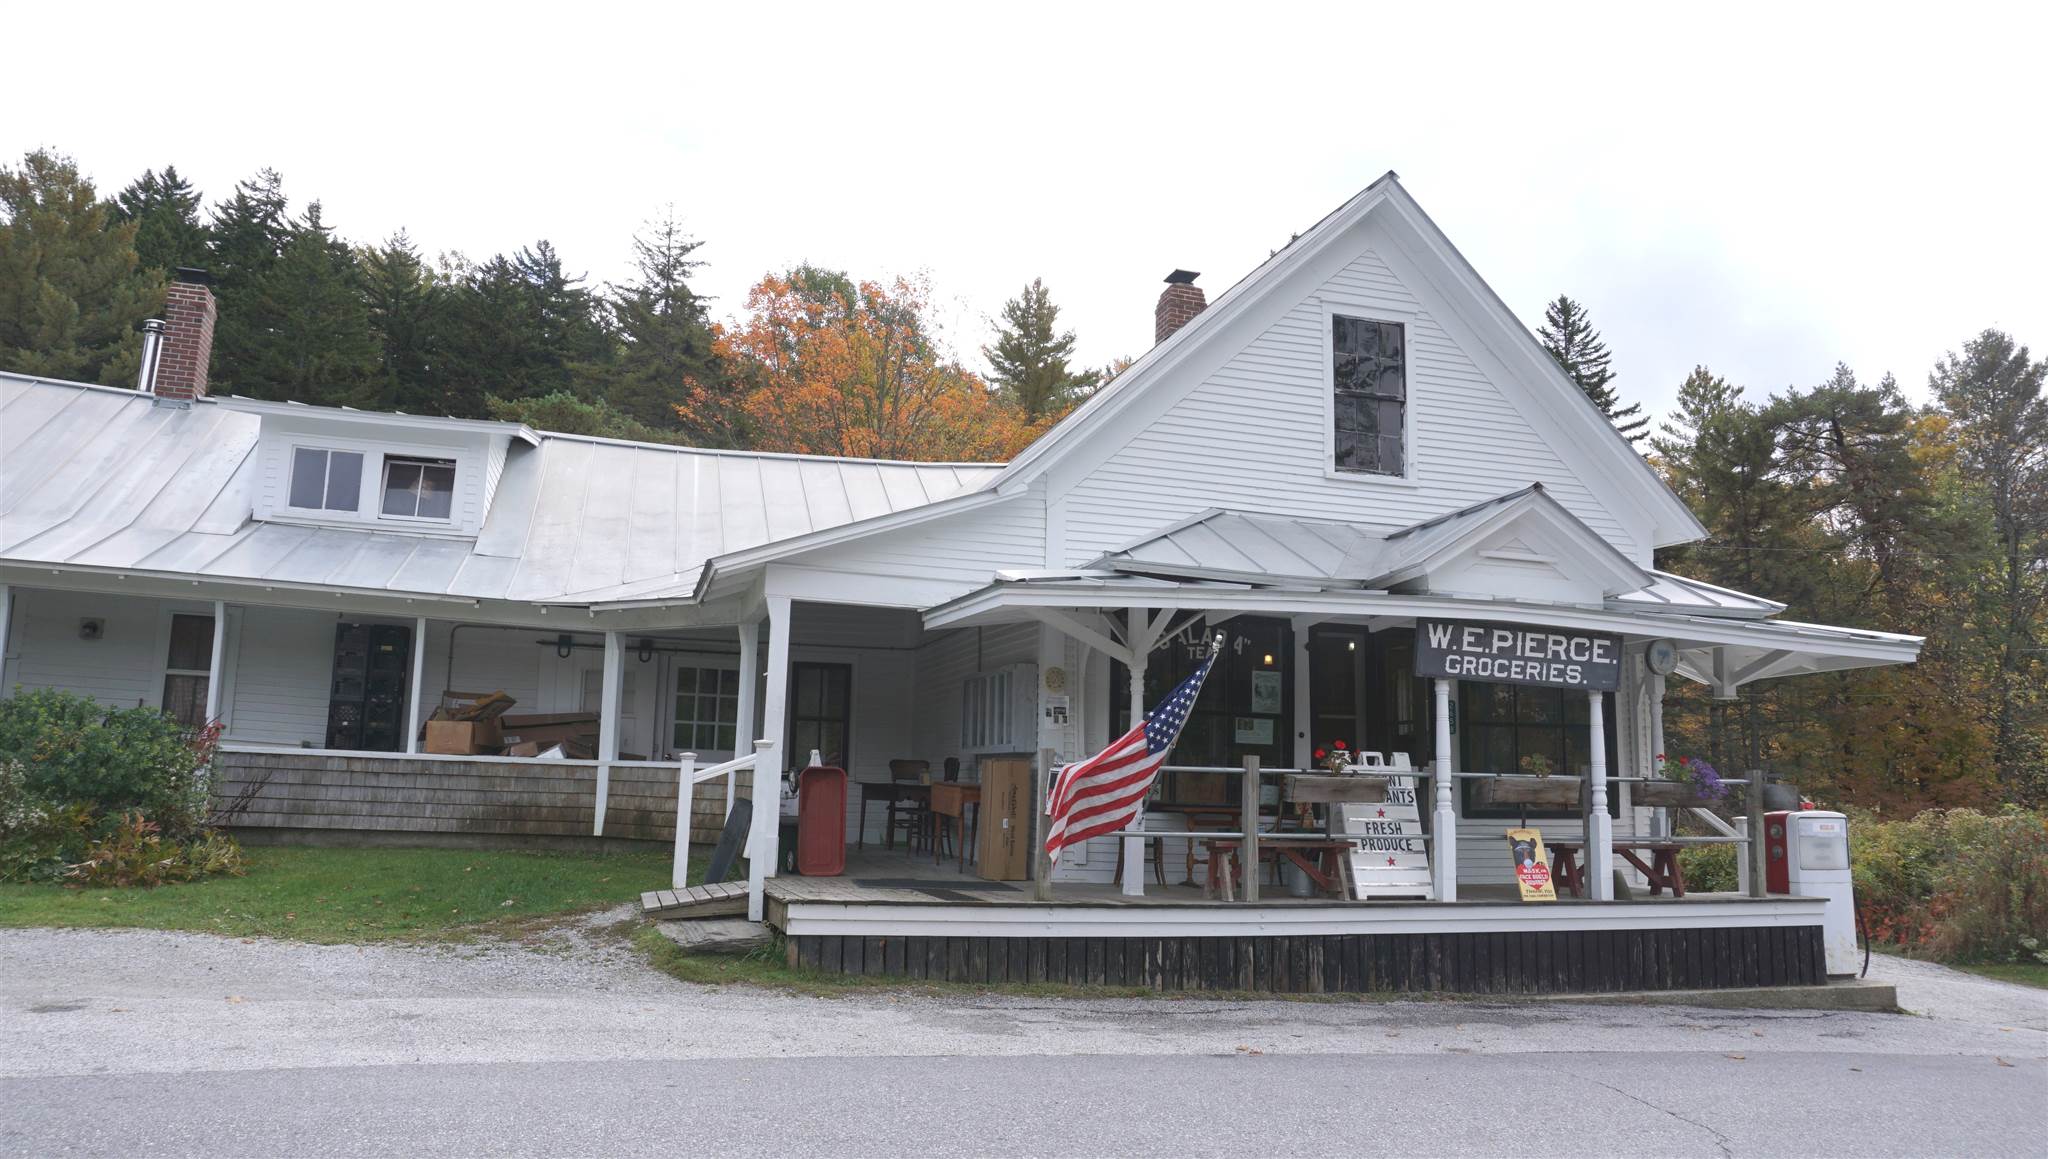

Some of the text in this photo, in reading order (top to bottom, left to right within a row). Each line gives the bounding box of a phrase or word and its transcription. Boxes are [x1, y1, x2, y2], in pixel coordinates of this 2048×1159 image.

[1445, 654, 1588, 684] GROCERIES.
[1386, 790, 1415, 804] ANTS
[1365, 822, 1403, 835] FRESH
[1361, 838, 1413, 851] PRODUCE
